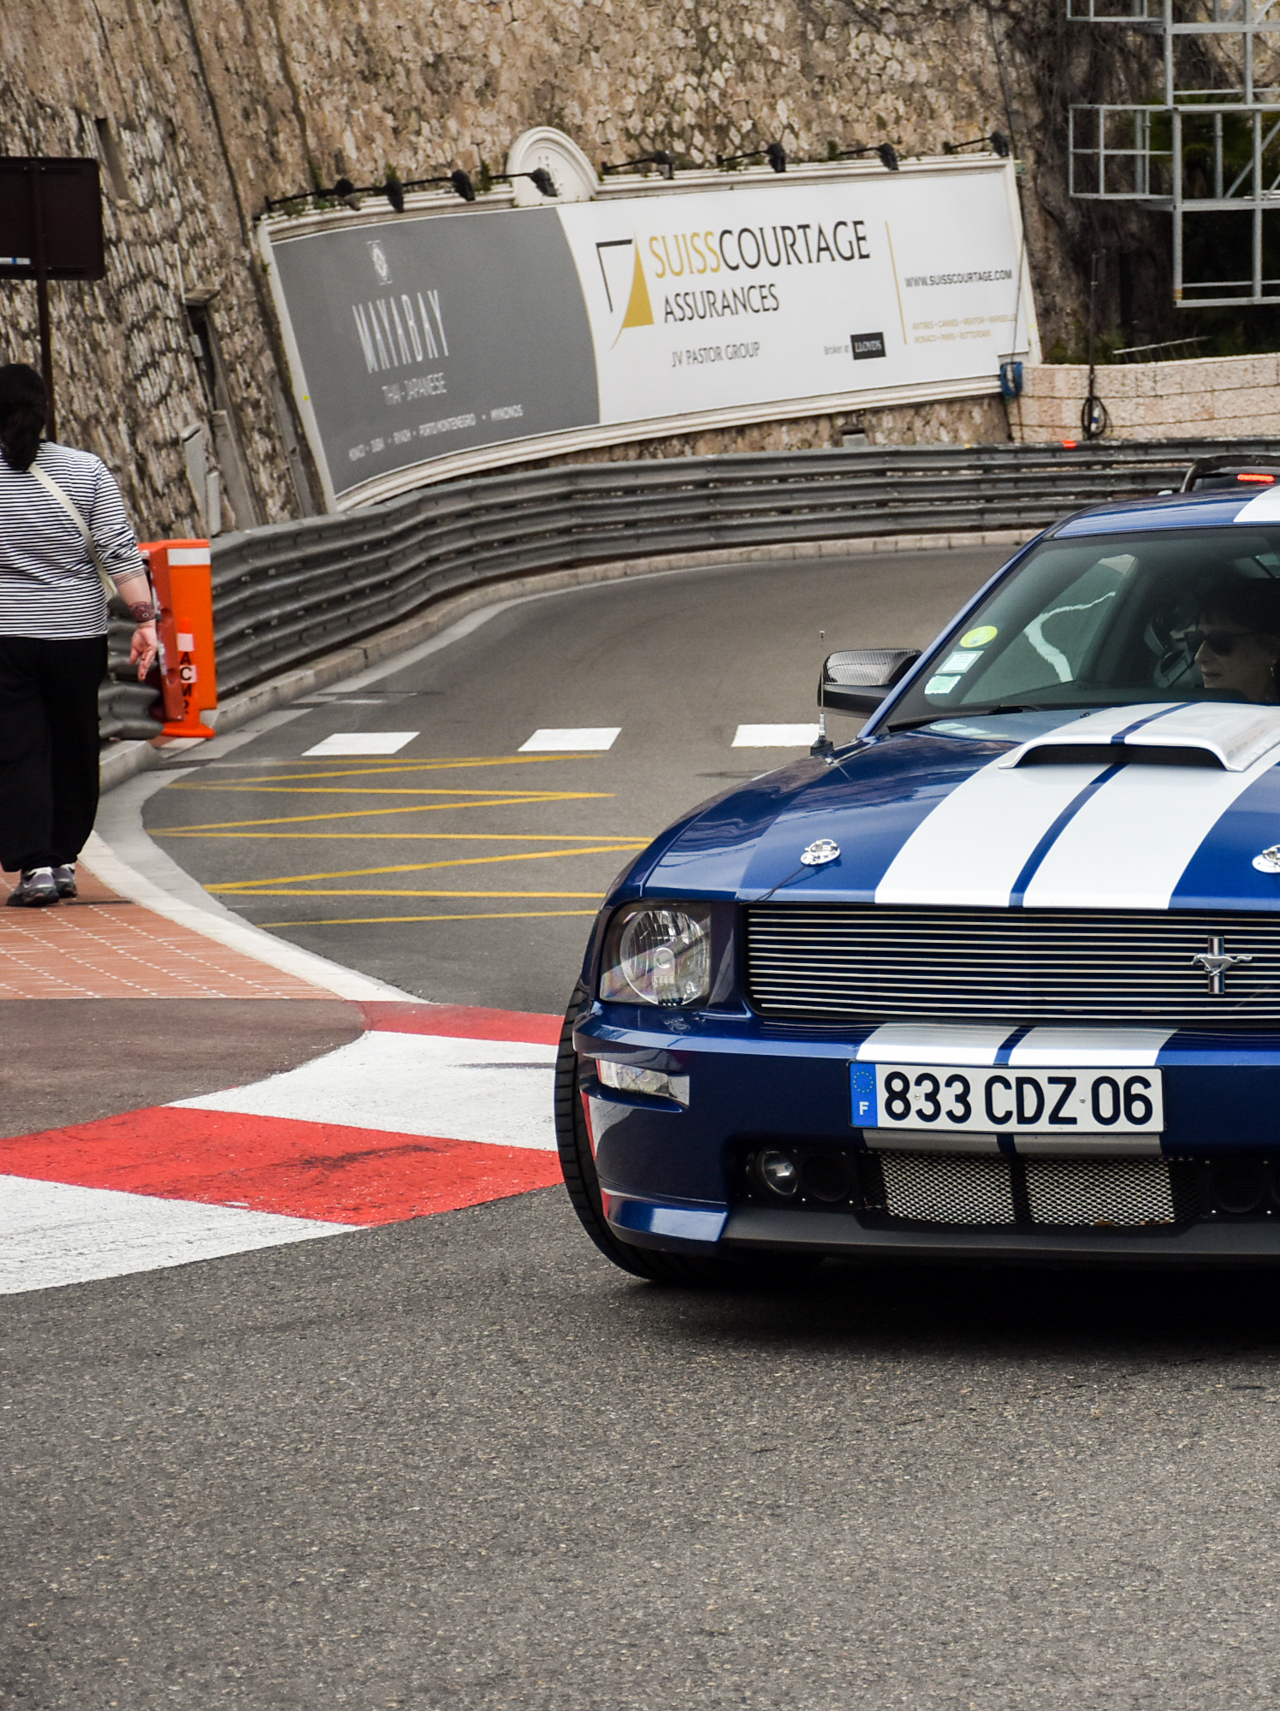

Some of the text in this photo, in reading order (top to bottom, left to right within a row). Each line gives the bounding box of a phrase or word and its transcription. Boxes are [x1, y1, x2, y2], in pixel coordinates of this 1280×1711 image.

[649, 220, 870, 278] SUISSCOURTAGE
[904, 269, 1013, 288] WWW.SUISSCOURTAGE.COM
[664, 283, 780, 323] ASSURANCES
[671, 341, 760, 368] JV PASTOR GROUP
[859, 1071, 1153, 1126] F 833 CDZ 06
